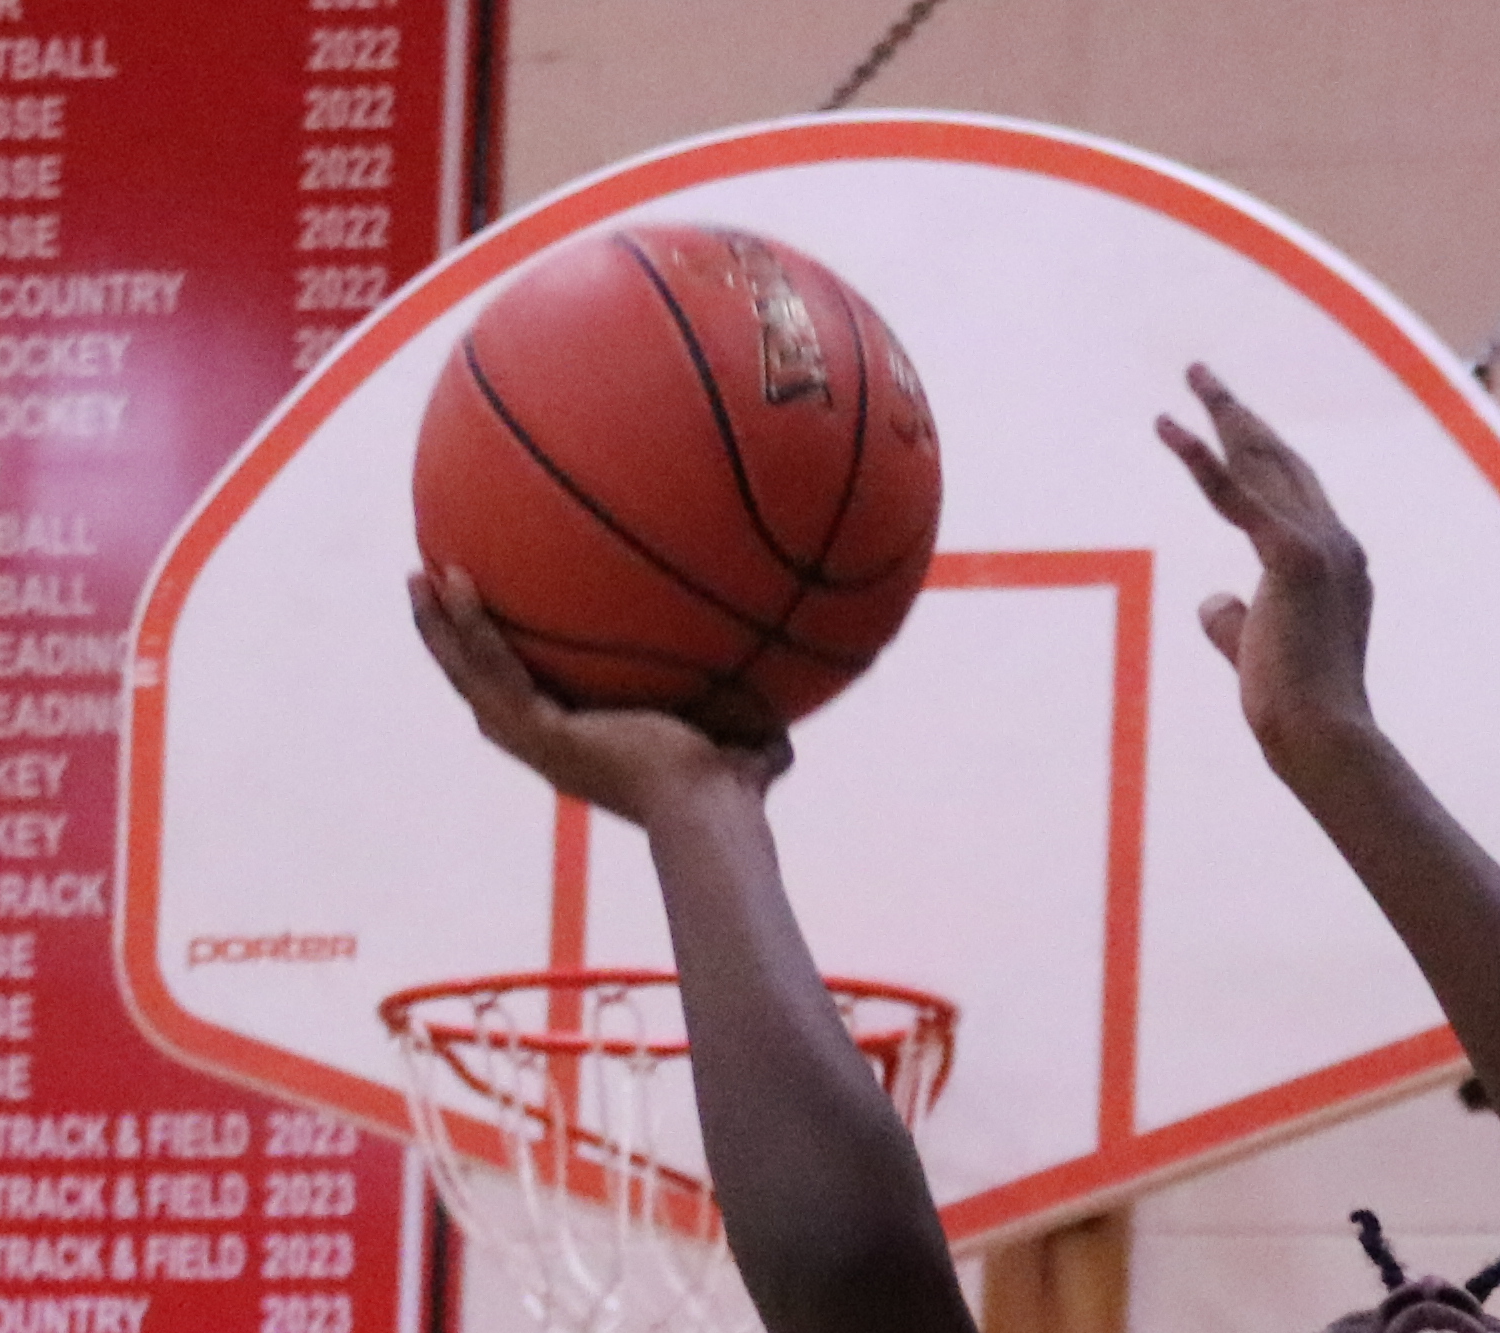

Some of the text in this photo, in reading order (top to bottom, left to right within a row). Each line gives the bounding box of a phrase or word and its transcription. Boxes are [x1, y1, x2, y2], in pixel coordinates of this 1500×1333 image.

[308, 27, 400, 71] 2022
[303, 85, 394, 130] 2022
[187, 932, 358, 969] porter
[112, 1175, 139, 1219] &
[146, 1172, 248, 1219] FIELD
[110, 1236, 137, 1280] &
[144, 1234, 246, 1280] FIELD
